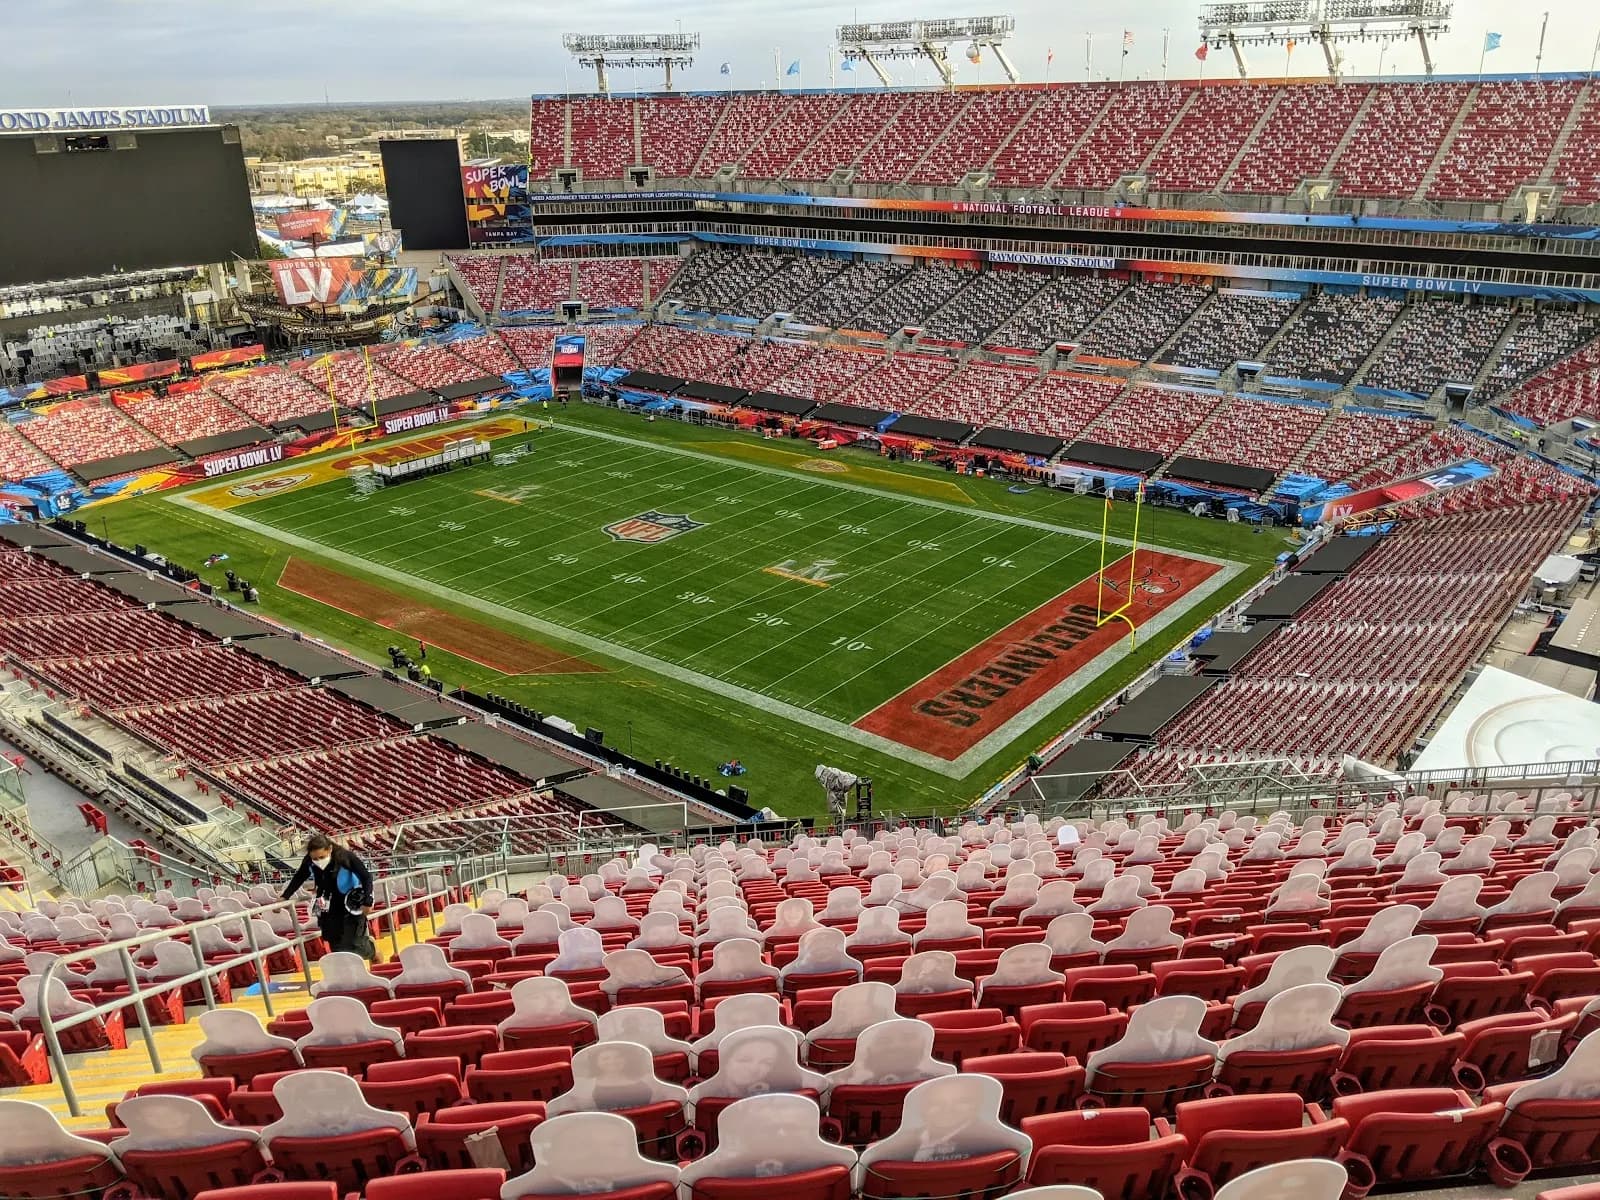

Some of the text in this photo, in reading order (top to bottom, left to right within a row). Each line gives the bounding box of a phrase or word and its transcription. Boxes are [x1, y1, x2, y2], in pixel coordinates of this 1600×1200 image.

[0, 107, 208, 129] OND JAMES STADIUM
[465, 166, 506, 185] SUPER
[490, 175, 527, 192] BOWL
[962, 203, 1110, 217] NATIONAL FOOTBALL LEAGUE
[754, 236, 817, 249] SUPER BOWL LV
[276, 260, 332, 270] SUPER BOWL
[989, 252, 1114, 269] RAYMOND JAMES STADIUM
[279, 267, 333, 305] LV
[1362, 275, 1481, 293] SUPER BOWL LV
[384, 415, 414, 434] SUPER
[413, 409, 439, 428] BOWL
[203, 445, 283, 477] SUPER BOWL LV
[611, 519, 674, 541] NFL
[548, 553, 579, 565] 50
[676, 591, 710, 605] 30
[747, 612, 784, 627] 20
[827, 636, 866, 651] 10
[911, 603, 1126, 728] BUCCANEERS
